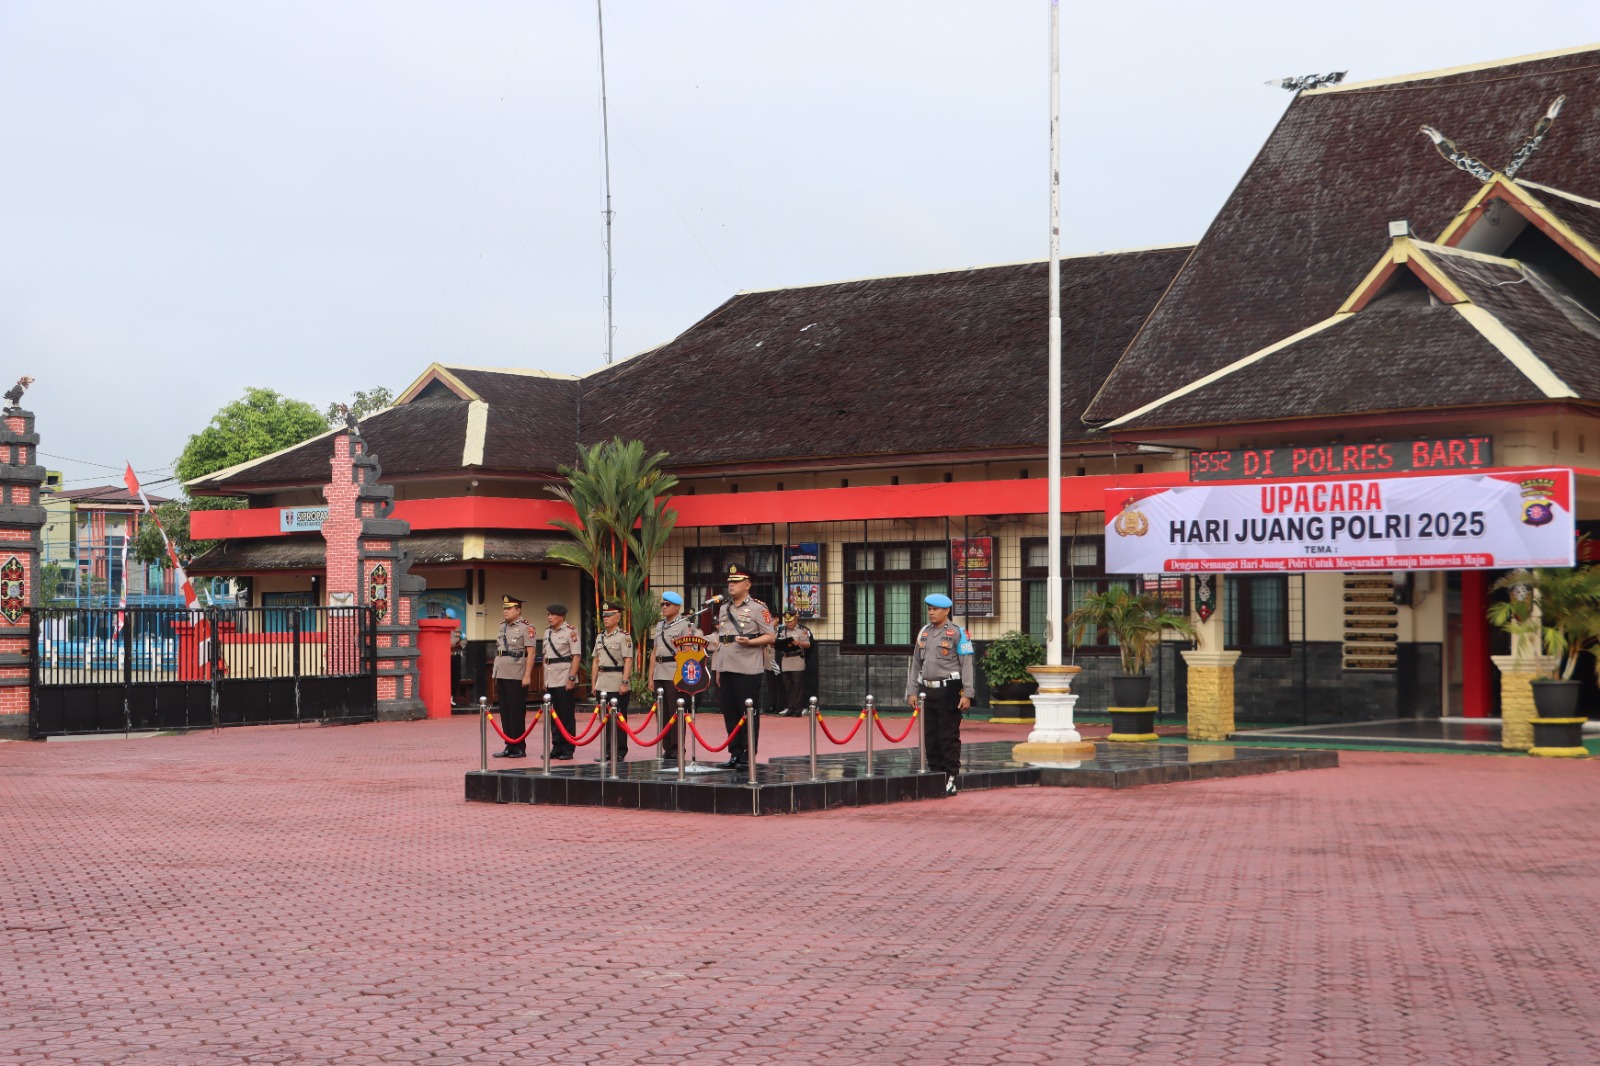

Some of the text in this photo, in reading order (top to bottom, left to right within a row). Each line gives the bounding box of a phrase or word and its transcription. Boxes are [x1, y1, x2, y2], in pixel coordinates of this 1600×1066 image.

[1243, 449, 1275, 476] DI
[1292, 443, 1394, 474] POLRES
[1412, 437, 1489, 468] BARI
[1260, 481, 1383, 514] UPACARA
[1169, 510, 1485, 544] HARI JUANG POLRI 2025
[1171, 560, 1199, 571] Dengan
[1200, 559, 1239, 571] Semangat
[1240, 559, 1258, 569] Hari
[1287, 558, 1307, 568] Polri
[1308, 557, 1334, 568] Untuk
[1335, 557, 1384, 569] Masyarakat
[1385, 556, 1417, 568] Menuju
[1419, 555, 1461, 567] Indonesia
[1462, 554, 1487, 567] Maju
[1304, 545, 1332, 554] TEMA
